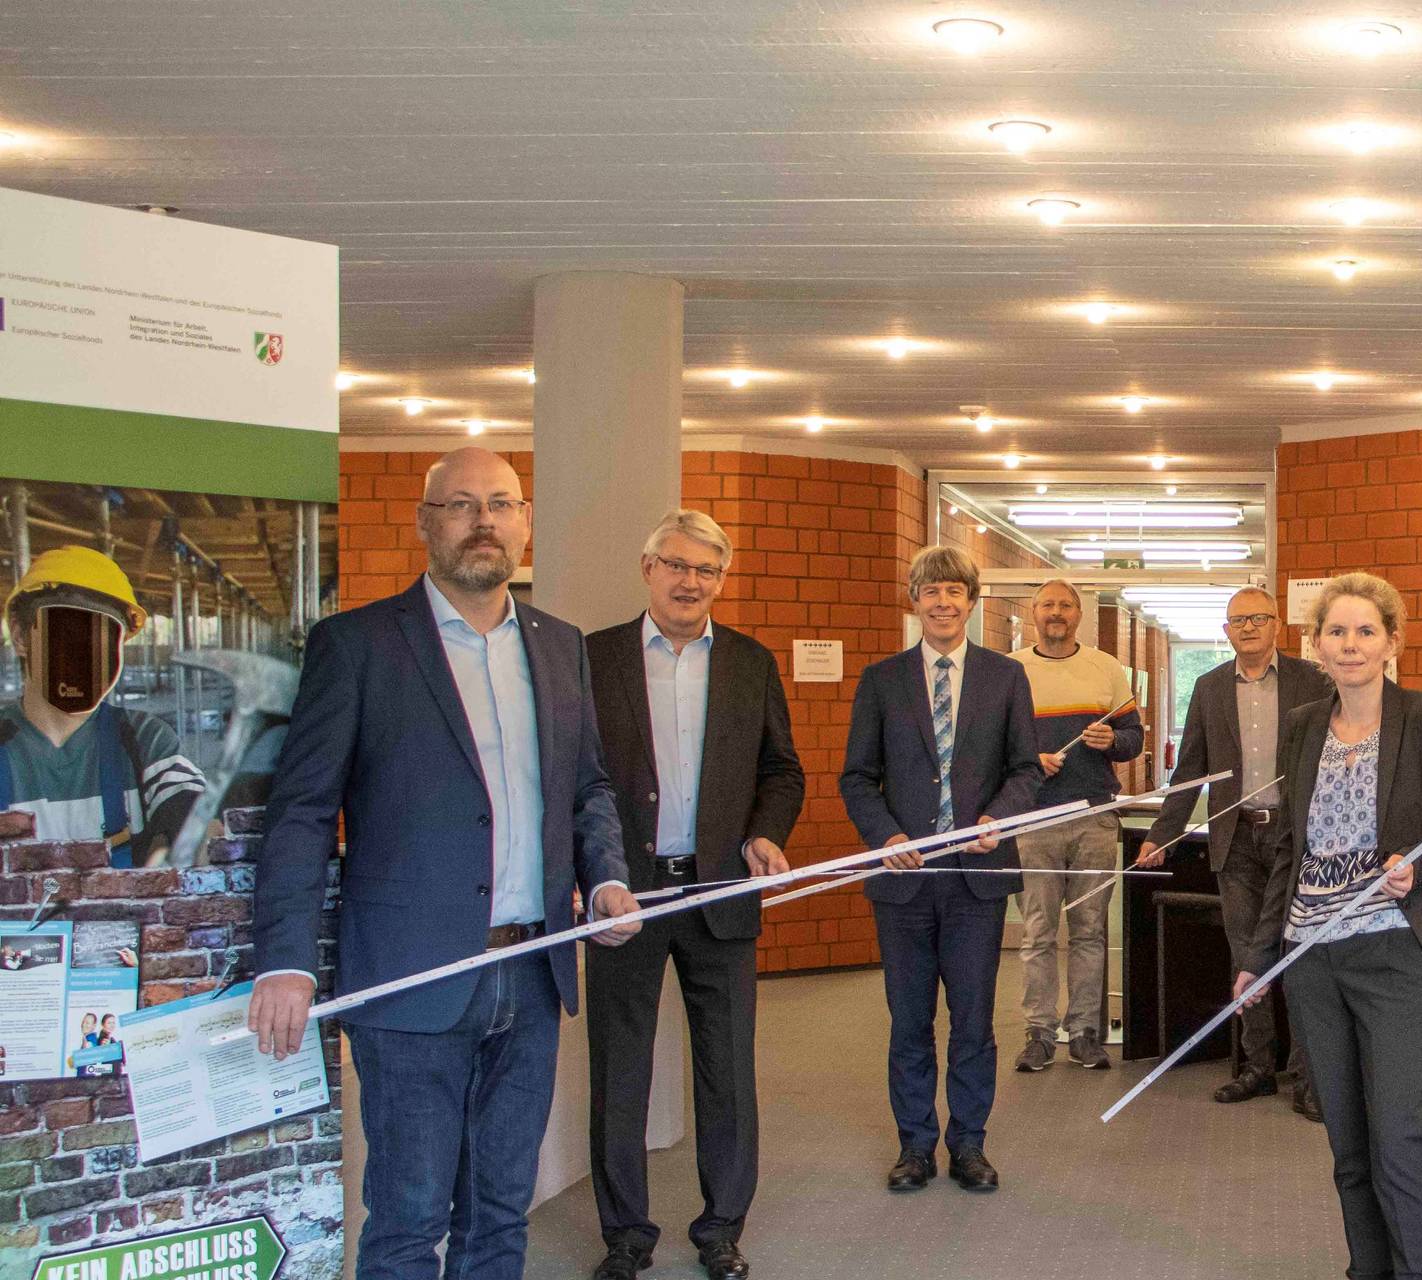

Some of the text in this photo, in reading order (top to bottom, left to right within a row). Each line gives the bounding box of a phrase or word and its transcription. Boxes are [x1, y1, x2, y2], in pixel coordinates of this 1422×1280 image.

[170, 328, 184, 337] und
[145, 334, 170, 345] Landes
[120, 1228, 258, 1280] ABSCHLUSS
